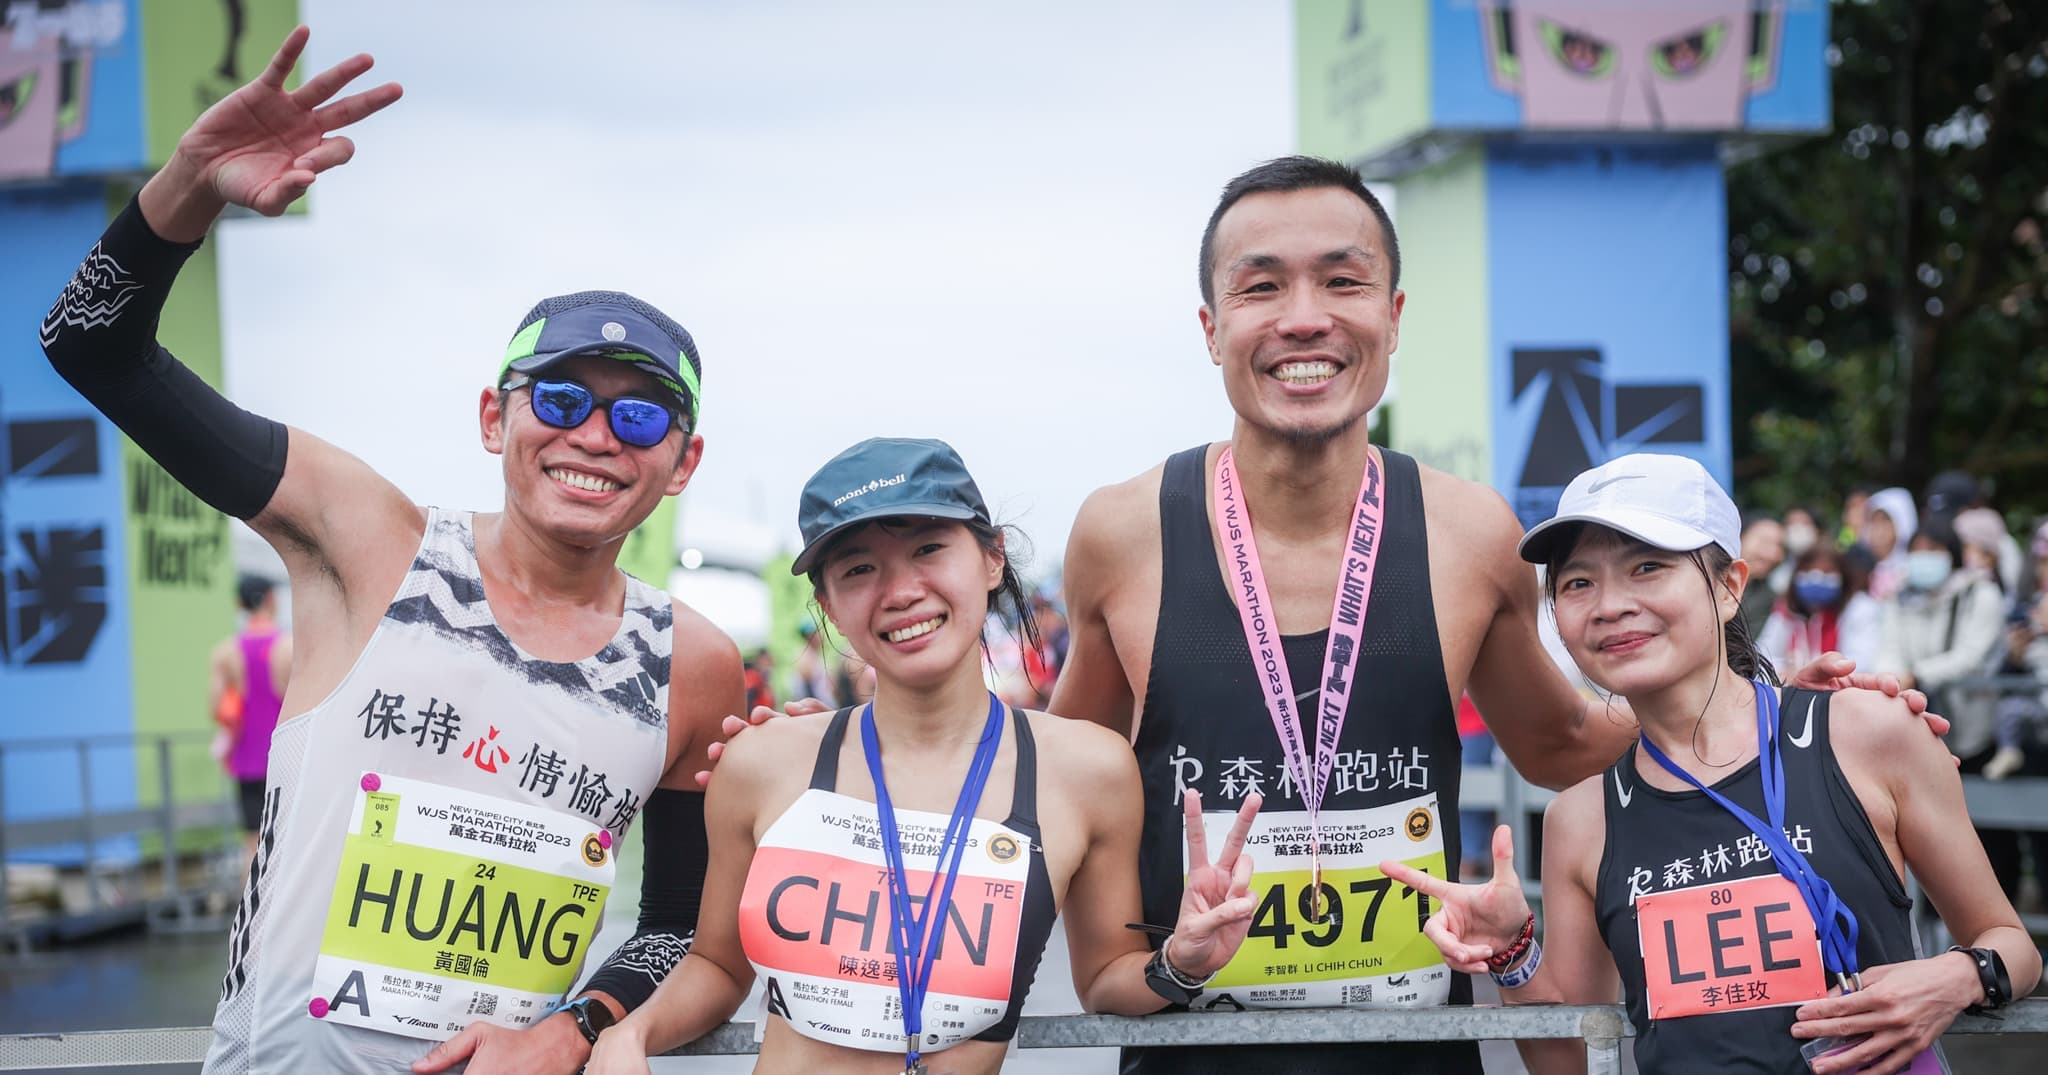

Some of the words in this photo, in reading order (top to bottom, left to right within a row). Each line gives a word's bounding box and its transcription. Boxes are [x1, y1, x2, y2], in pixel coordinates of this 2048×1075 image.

[1220, 467, 1234, 501] CITY
[1225, 504, 1242, 540] WJS
[1352, 508, 1377, 558] NEXT
[1233, 543, 1270, 646] MARATHON
[1338, 558, 1368, 626] WHAT'S
[1262, 648, 1284, 695] 2023
[1320, 698, 1342, 750] NEXT
[358, 688, 640, 838] 保持心情愉快
[375, 803, 390, 812] 085
[450, 804, 472, 814] NEW
[474, 808, 502, 821] TAIPEI
[504, 815, 524, 825] CITY
[418, 805, 448, 820] WJS
[452, 812, 534, 838] MARATHON
[536, 831, 572, 847] 2023
[821, 814, 850, 829] WJS
[854, 822, 936, 842] MARTHON
[940, 836, 978, 848] 203
[852, 813, 873, 824] NEW
[906, 824, 926, 832] CITY
[1273, 832, 1356, 842] MARATHON
[1360, 826, 1395, 840] 2023
[449, 823, 538, 854] 萬金石馬拉松
[852, 832, 942, 856] 萬金馬拉松
[475, 863, 496, 880] 24
[572, 883, 600, 902] TPE
[984, 882, 1015, 900] TPE
[1710, 888, 1732, 906] 80
[347, 862, 586, 966] HUANG
[766, 876, 994, 966] CHEN
[1663, 902, 1801, 986] LEE
[434, 950, 490, 978] 黃國倫
[1264, 964, 1298, 976] 李智群
[1304, 964, 1314, 973] LI
[1316, 961, 1346, 972] CHIH
[1348, 957, 1382, 970] CHUN
[328, 969, 371, 1018] A
[380, 985, 421, 999] MARATHON
[423, 993, 440, 1002] MALE
[382, 974, 412, 989] 馬拉松
[794, 981, 818, 992] 馬拉松
[822, 986, 849, 998] 女子組
[1701, 980, 1771, 1008] 李佳玫
[768, 976, 792, 1020] A
[793, 992, 828, 1004] MARATHON
[830, 998, 854, 1008] FEMALE
